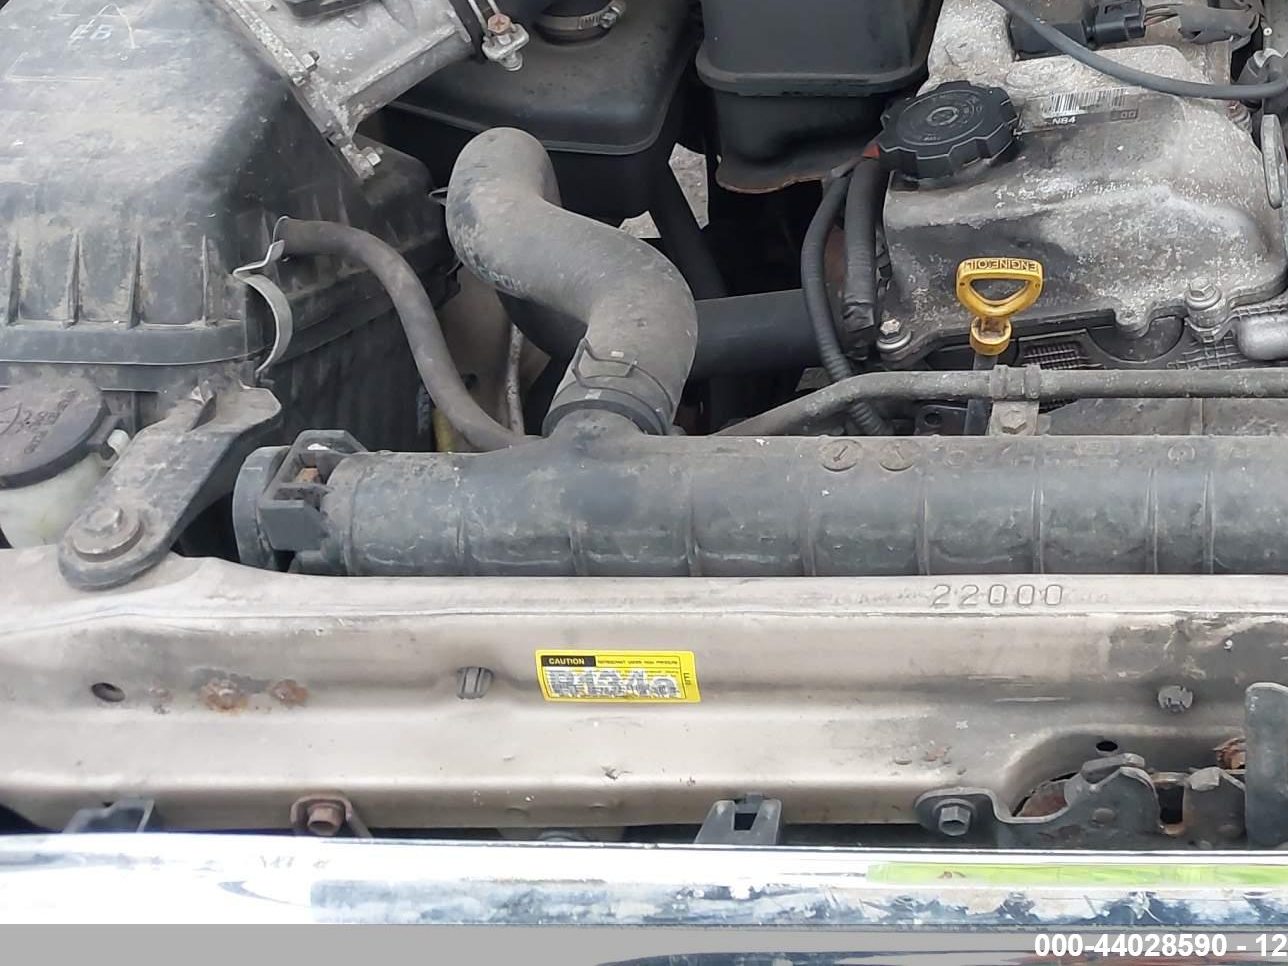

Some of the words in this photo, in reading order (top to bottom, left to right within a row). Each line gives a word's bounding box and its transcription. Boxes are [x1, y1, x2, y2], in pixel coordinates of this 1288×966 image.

[988, 259, 1039, 273] ENGINE
[930, 583, 1063, 607] 22000
[547, 657, 586, 666] CAUTION
